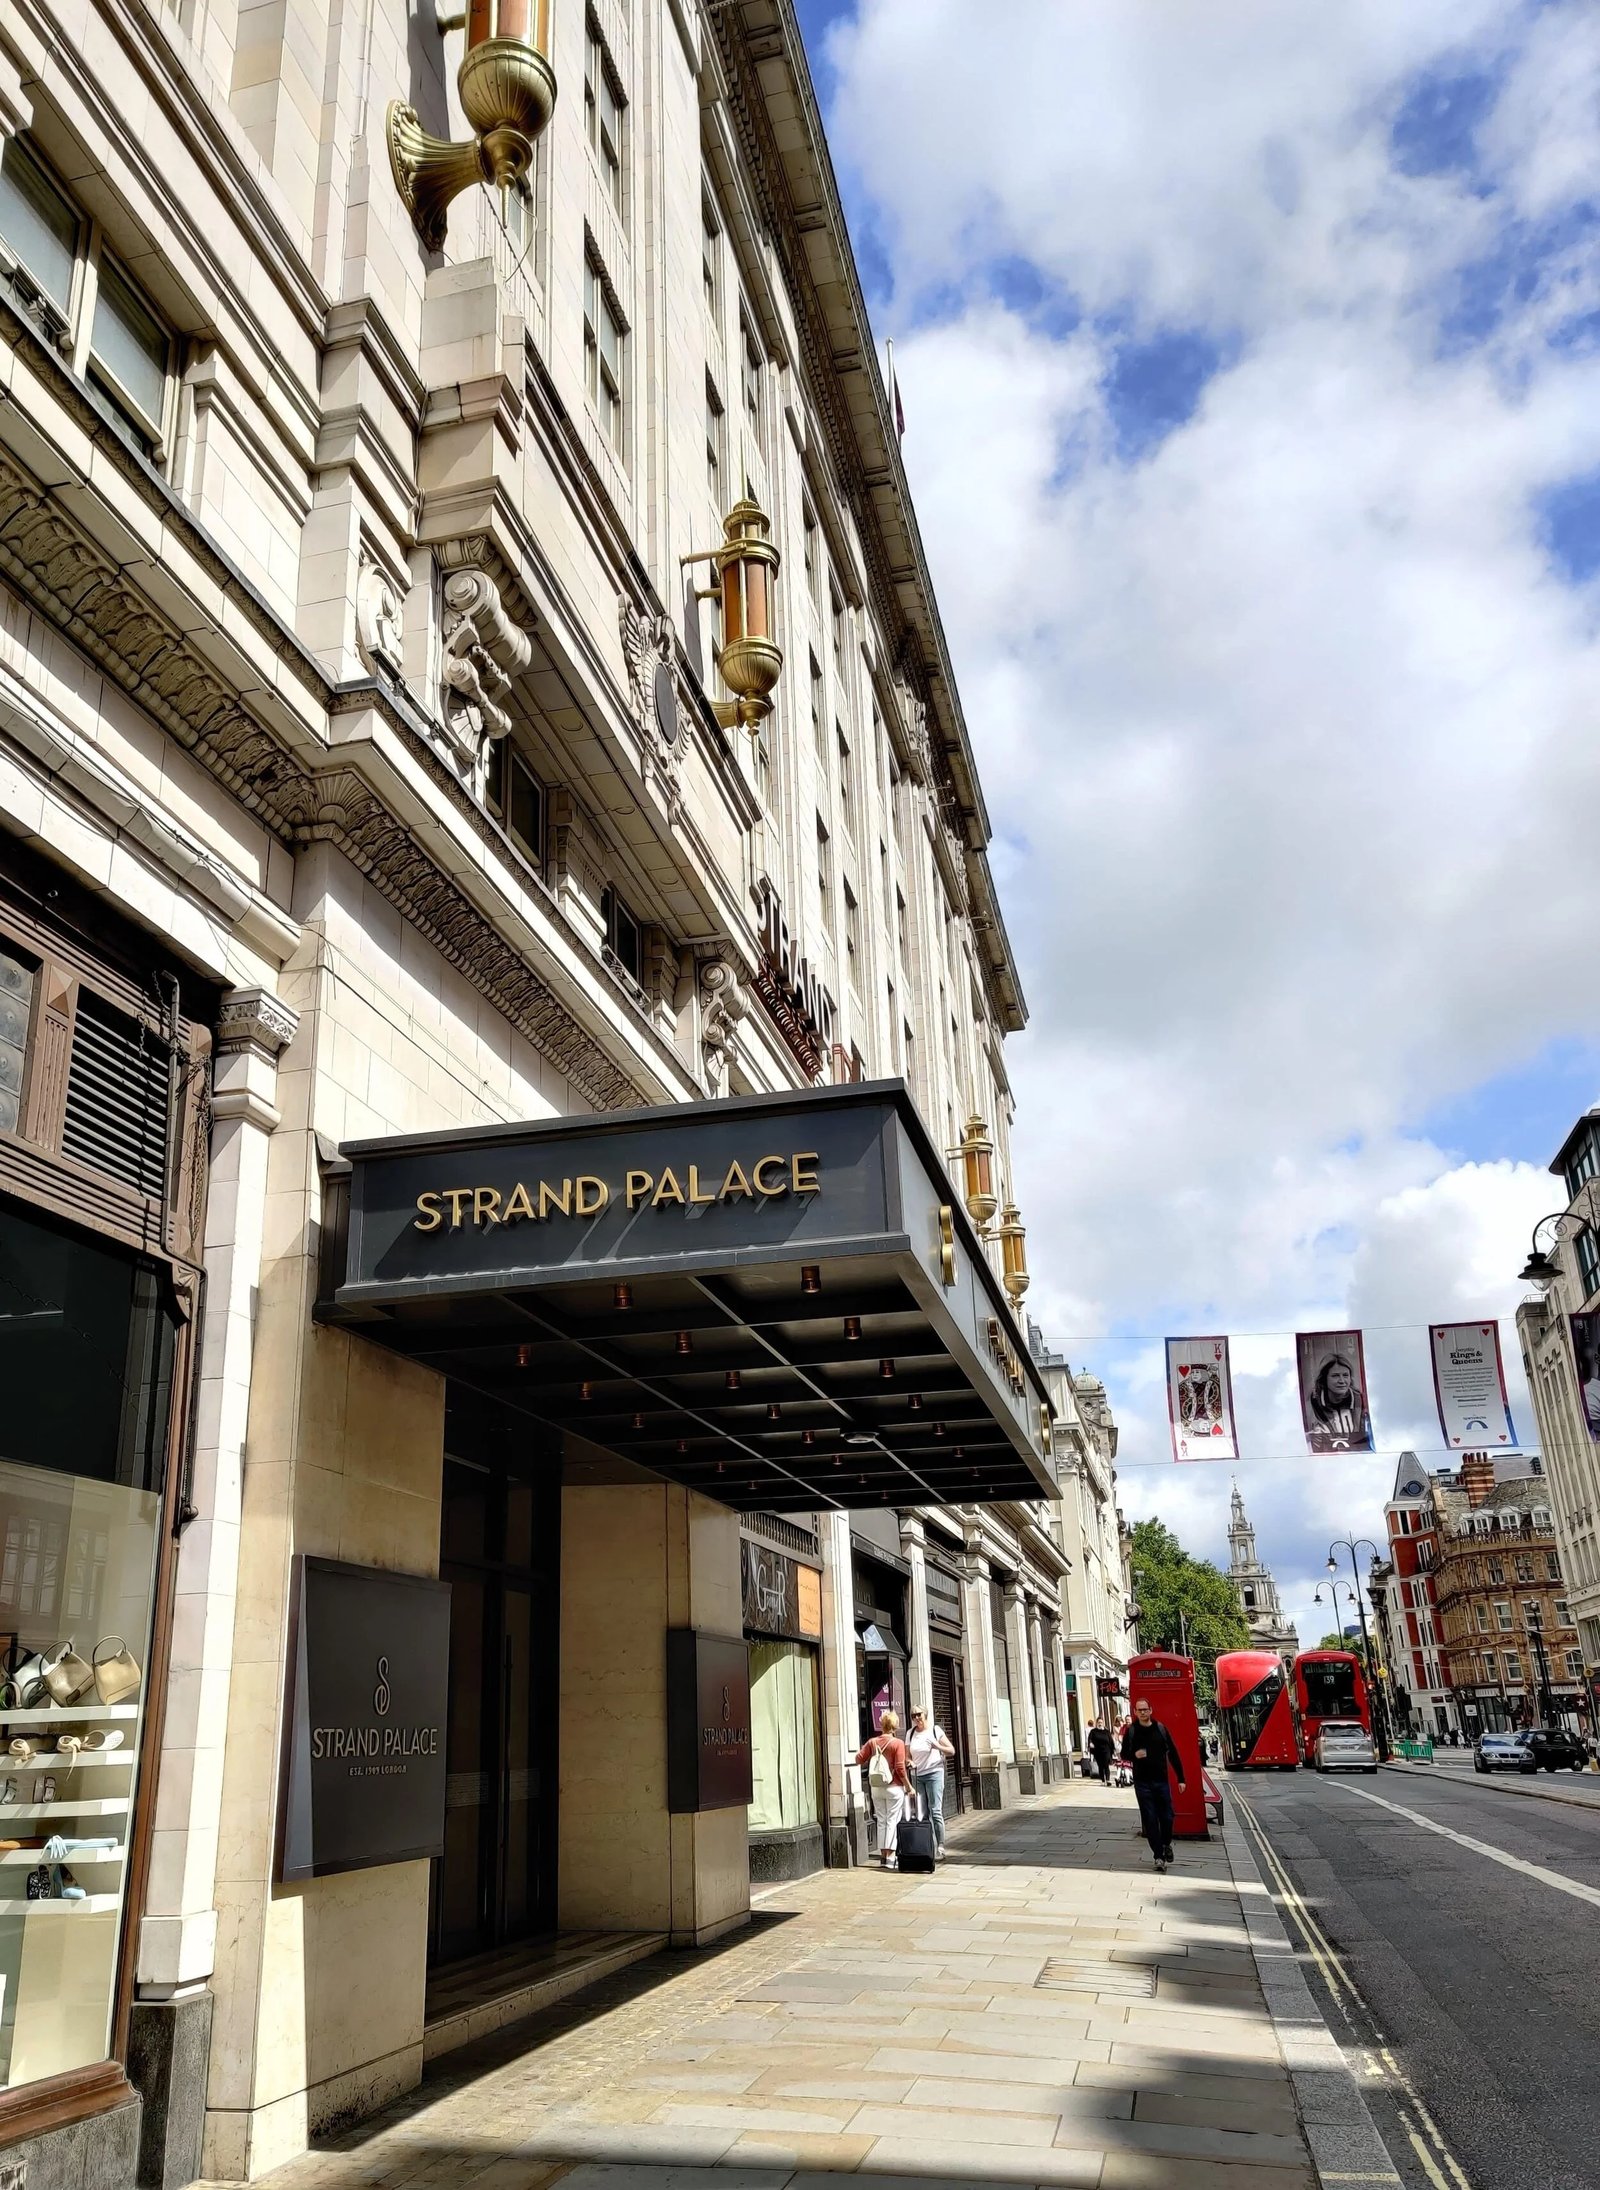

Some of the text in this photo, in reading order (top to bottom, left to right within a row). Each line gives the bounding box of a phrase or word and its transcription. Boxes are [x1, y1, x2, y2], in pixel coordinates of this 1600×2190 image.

[413, 1151, 820, 1233] STRAND PALACE
[1323, 1675, 1335, 1684] 139
[1253, 1695, 1262, 1704] 15
[312, 1727, 438, 1759] STRAND PALACE
[703, 1728, 749, 1746] STRAND PALACE
